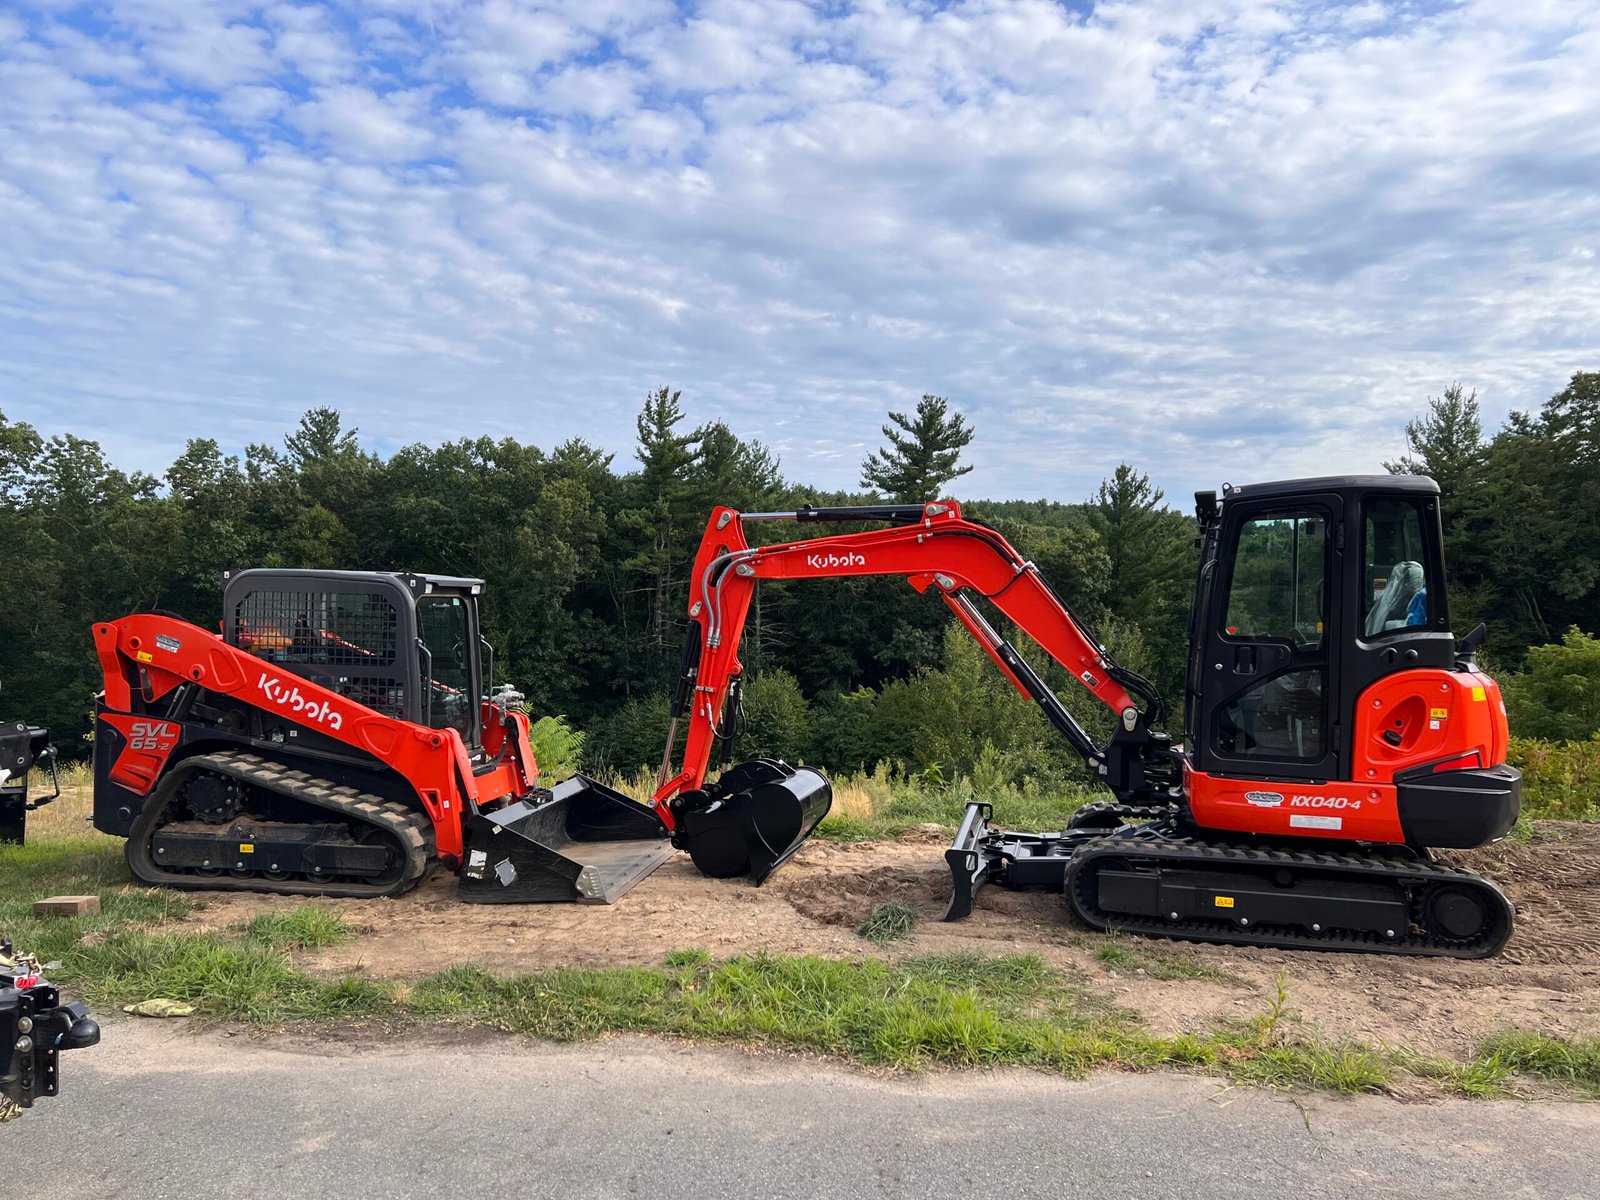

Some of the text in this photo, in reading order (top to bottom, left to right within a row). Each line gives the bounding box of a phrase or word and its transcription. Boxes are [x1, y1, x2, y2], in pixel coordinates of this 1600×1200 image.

[807, 552, 864, 568] Kubota
[258, 673, 342, 730] Kubota
[129, 723, 176, 737] SVL
[1291, 795, 1361, 809] KX040-4
